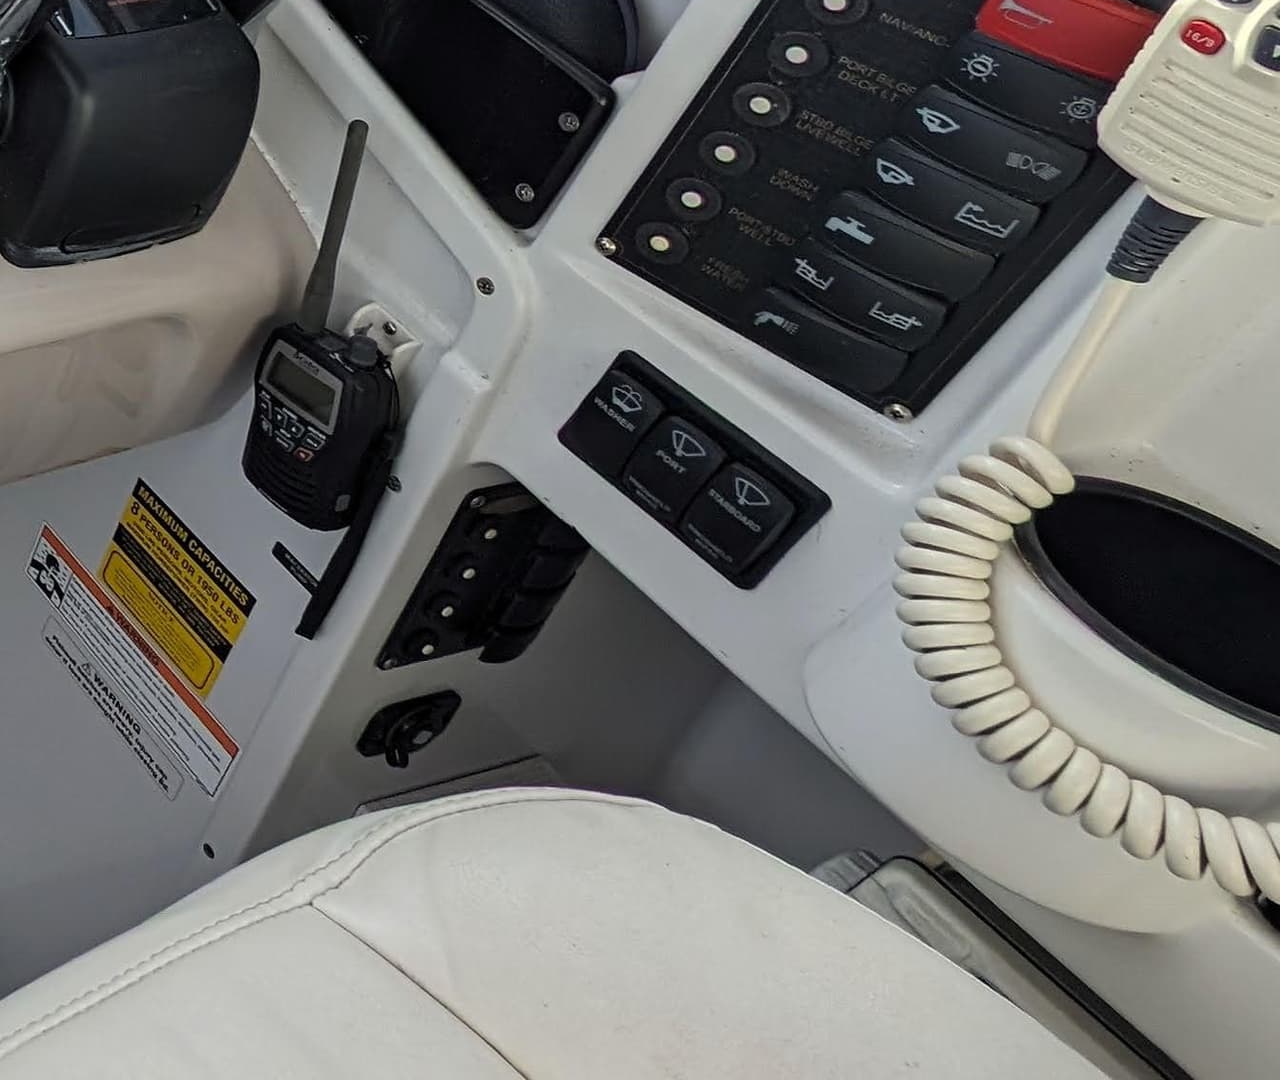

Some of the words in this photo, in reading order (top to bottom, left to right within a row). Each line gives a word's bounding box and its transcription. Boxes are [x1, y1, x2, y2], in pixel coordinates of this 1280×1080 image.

[1185, 29, 1216, 48] 16/9
[838, 55, 878, 77] PORT
[593, 395, 636, 433] WASHER
[655, 448, 687, 474] PORT
[708, 487, 762, 533] STARBOARD
[129, 499, 141, 517] 8
[138, 511, 181, 562] PERSONS
[179, 556, 196, 578] OR
[195, 573, 220, 604] 1950
[218, 599, 240, 627] LBS
[136, 483, 189, 544] MAXIMUM
[186, 536, 250, 608] CAPACITIES
[91, 672, 142, 736] WARNING
